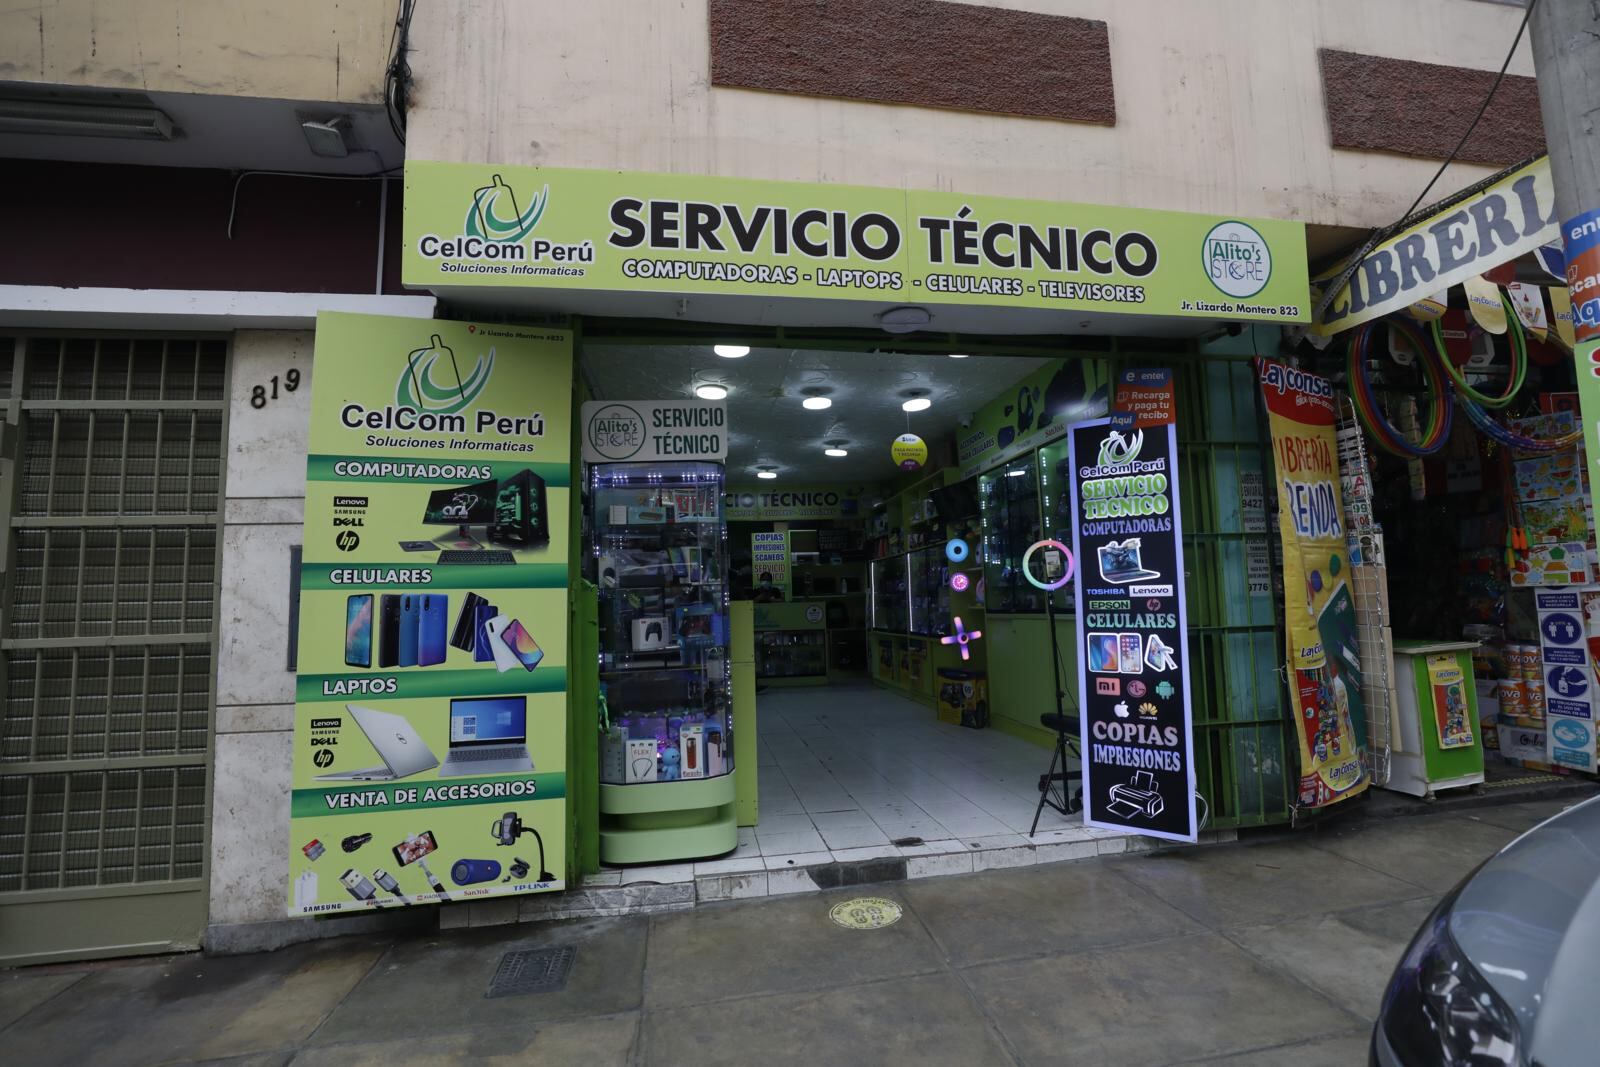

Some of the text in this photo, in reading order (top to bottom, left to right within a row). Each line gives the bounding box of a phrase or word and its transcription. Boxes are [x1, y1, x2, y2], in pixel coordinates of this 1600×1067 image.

[608, 198, 1157, 277] SERVICIO TÉCNICO
[420, 236, 593, 263] CelCom Perú
[1212, 242, 1262, 262] Alito's
[1322, 174, 1559, 325] LIBRERI
[440, 261, 585, 276] Soluciones Informaticas
[622, 258, 798, 284] COMPUTADORAS
[816, 268, 902, 290] LAPTOPS
[926, 274, 1023, 296] CELULARES
[1038, 280, 1146, 302] TELEVISORES
[1180, 301, 1299, 316] Jr. Lizardo Montero 823
[1141, 372, 1164, 380] entel
[250, 368, 301, 409] 819
[1131, 391, 1170, 402] Recarga
[1134, 402, 1158, 411] paga
[1159, 400, 1170, 409] tu
[341, 403, 544, 436] CelCom Perú
[652, 408, 724, 428] SERVICIO
[1138, 411, 1169, 420] recibo
[597, 420, 638, 432] Alito's
[365, 434, 535, 453] Soluciones Informaticas
[653, 432, 720, 454] TÉCNICO
[334, 461, 492, 480] COMPUTADORAS
[1080, 457, 1166, 477] CelCom Perú
[1081, 474, 1167, 500] SERVICIO
[335, 498, 367, 506] Lenovo
[760, 489, 839, 507] TÉCNICO
[1082, 494, 1169, 519] TECNICO
[333, 517, 364, 527] DELL
[1082, 517, 1172, 537] COMPUTADORAS
[336, 530, 360, 552] hp
[755, 533, 784, 541] COPIAS
[329, 569, 433, 584] CELULARES
[1086, 588, 1126, 596] TOSHIBA
[1132, 587, 1170, 595] Lenovo
[1091, 601, 1129, 609] EPSON
[1086, 613, 1177, 629] CELULARES
[322, 677, 398, 696] LAPTOS
[1092, 720, 1179, 747] COPIAS
[1093, 744, 1181, 773] IMPRESIONES
[325, 780, 536, 810] VENTA DE ACCESORIOS
[303, 903, 342, 912] SAMSUNG
